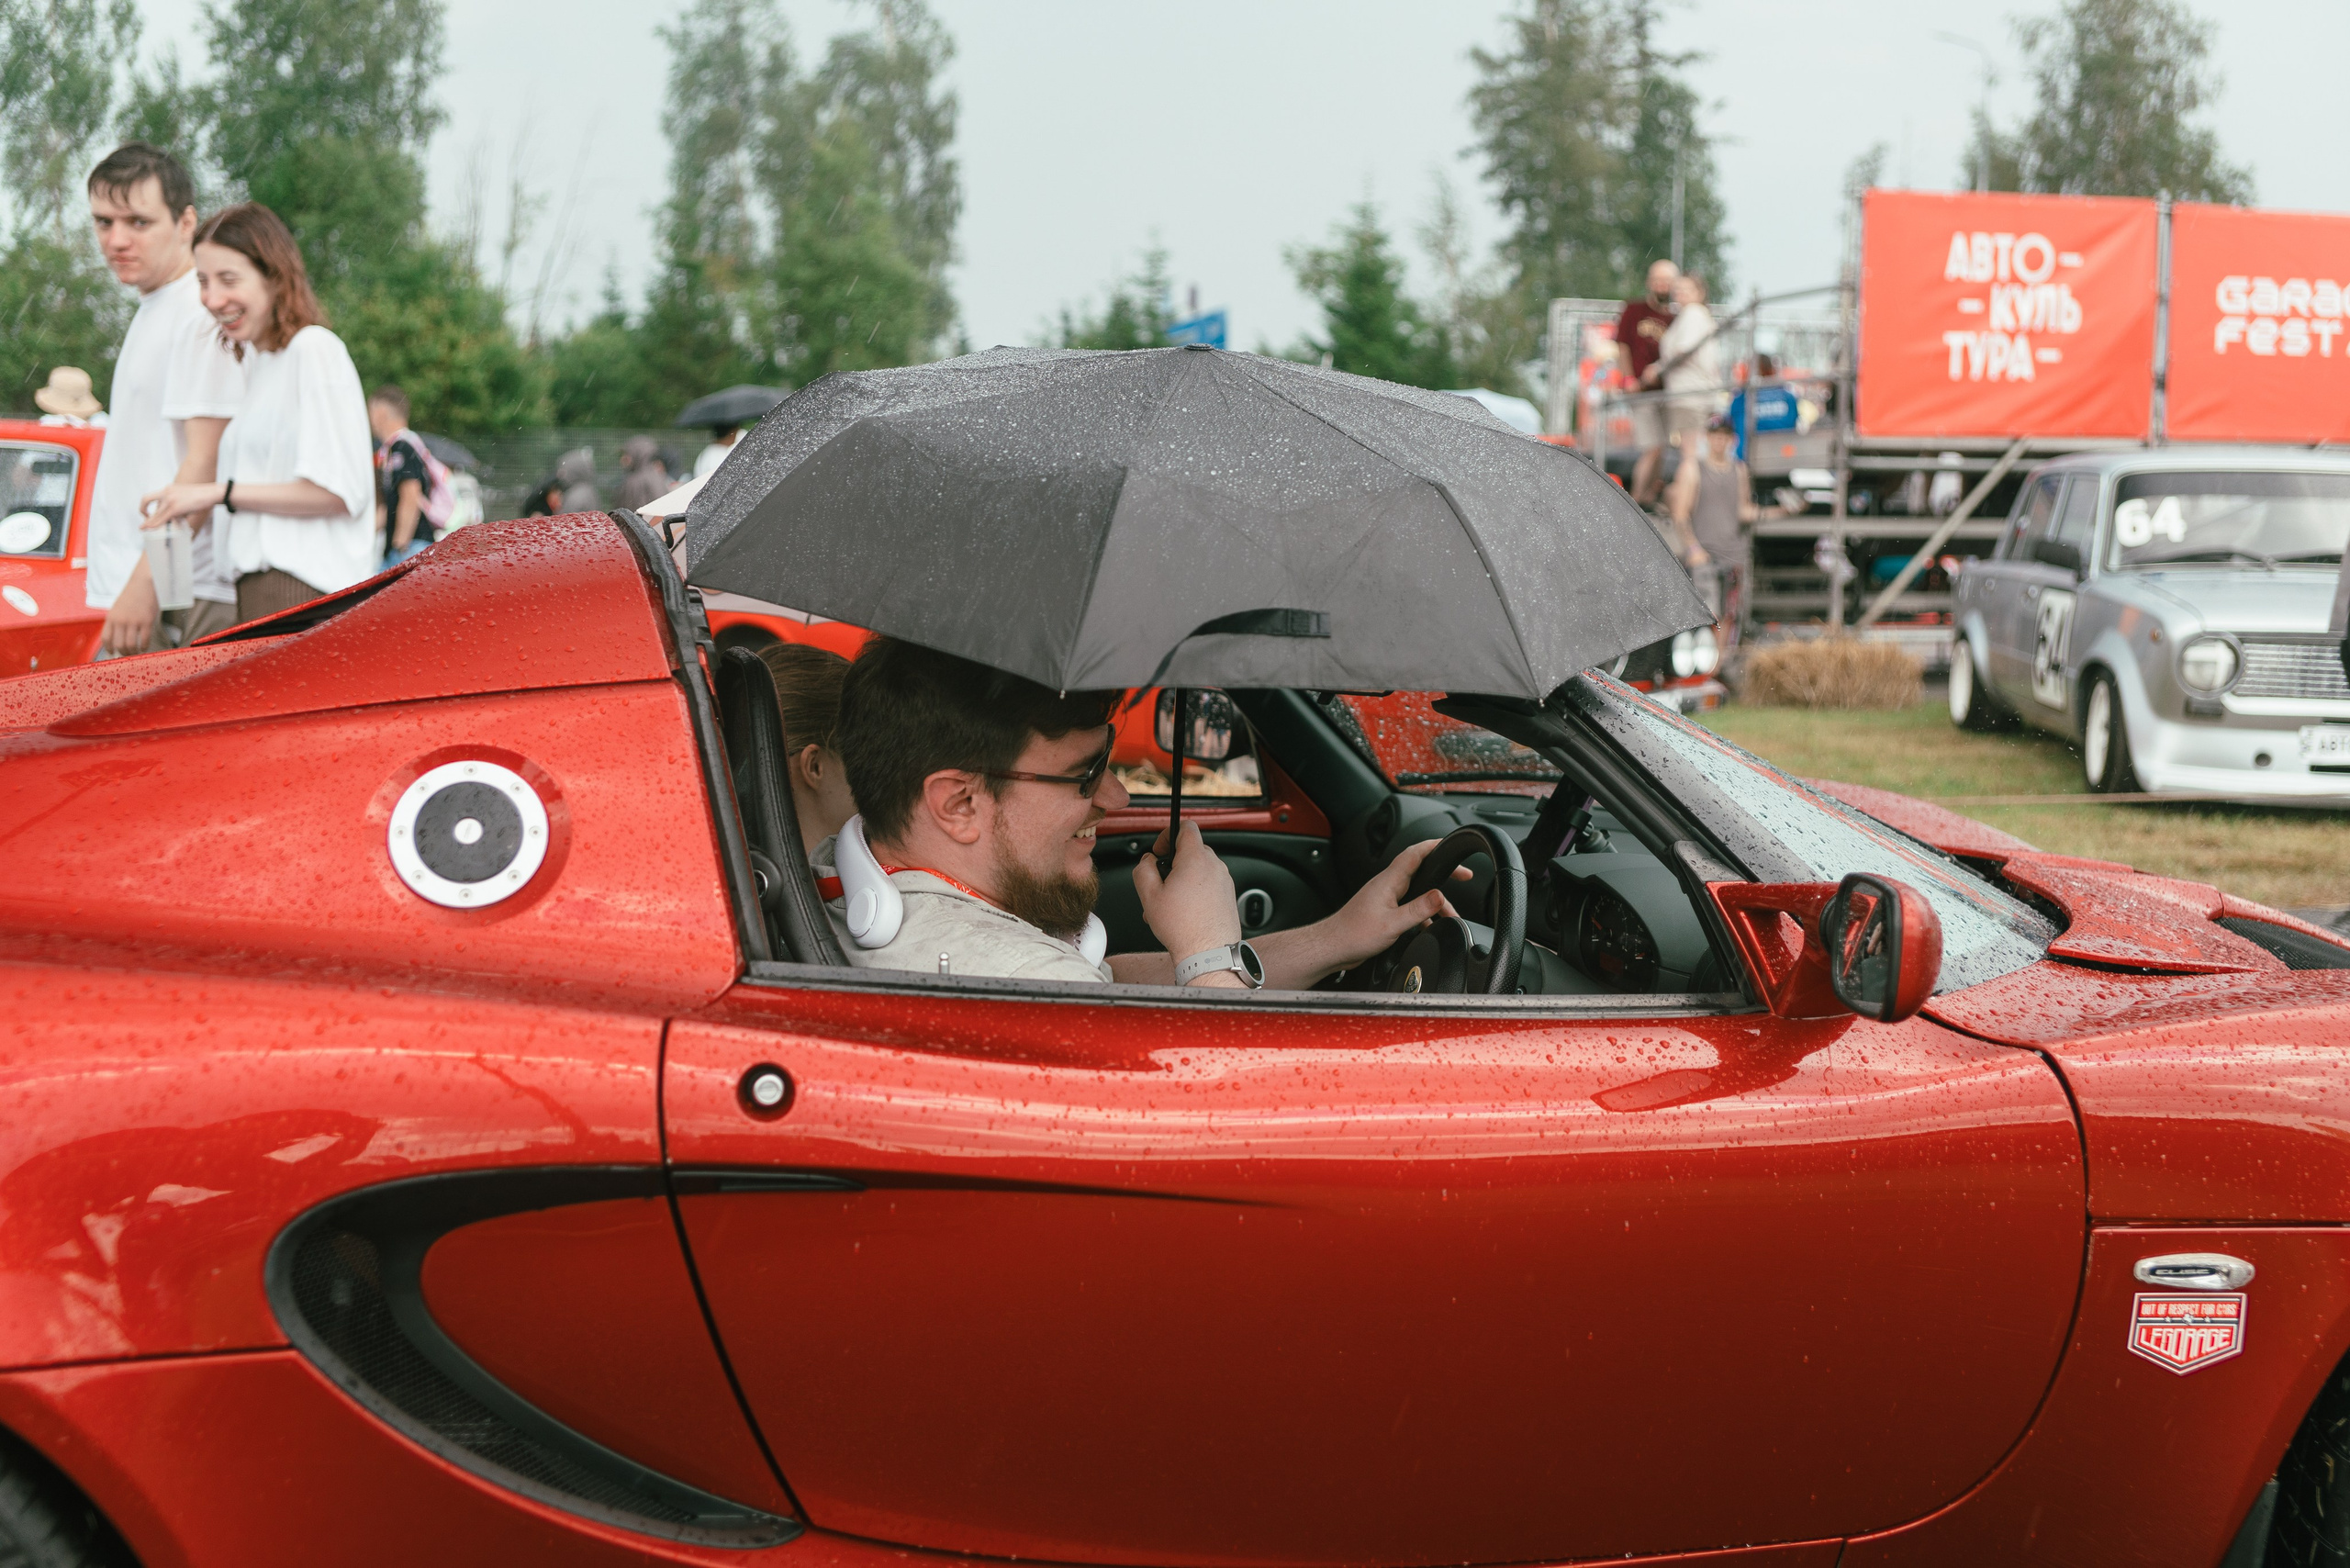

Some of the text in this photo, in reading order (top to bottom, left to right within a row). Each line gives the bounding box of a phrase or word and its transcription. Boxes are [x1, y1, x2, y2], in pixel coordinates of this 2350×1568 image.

[2114, 496, 2187, 547] 64
[2141, 1304, 2156, 1316] OUT
[2157, 1304, 2167, 1316] OF
[2168, 1304, 2199, 1316] RESPECT
[2200, 1304, 2215, 1316] FOR
